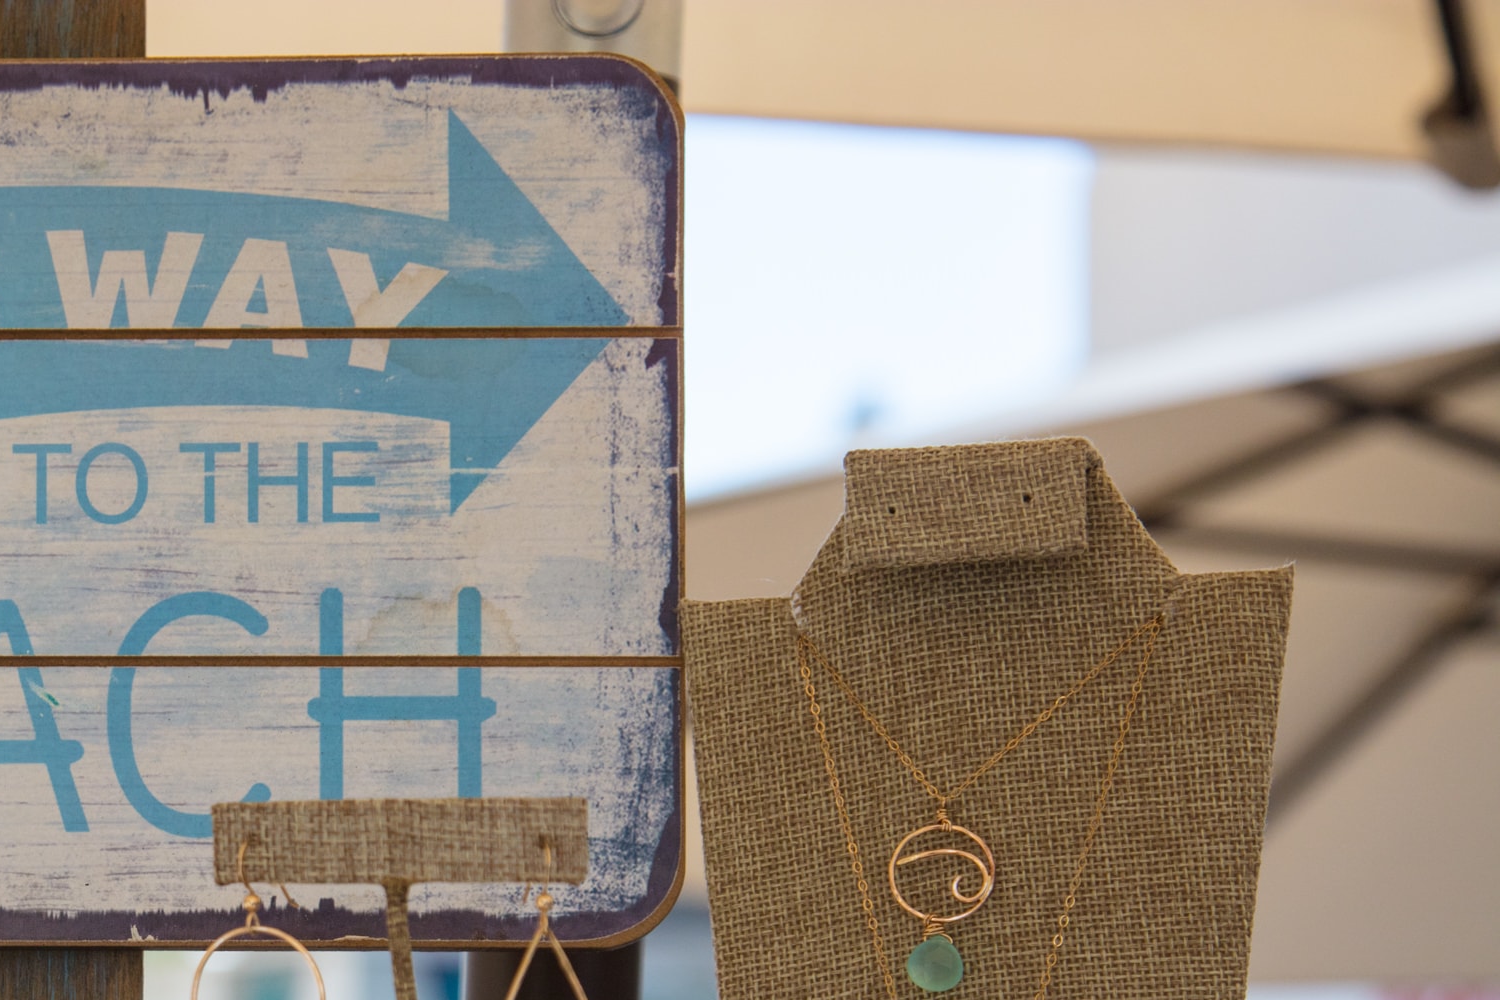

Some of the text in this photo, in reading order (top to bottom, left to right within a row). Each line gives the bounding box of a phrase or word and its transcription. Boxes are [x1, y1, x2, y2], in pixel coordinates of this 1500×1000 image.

[45, 229, 450, 372] WAY
[12, 441, 381, 525] TO THE
